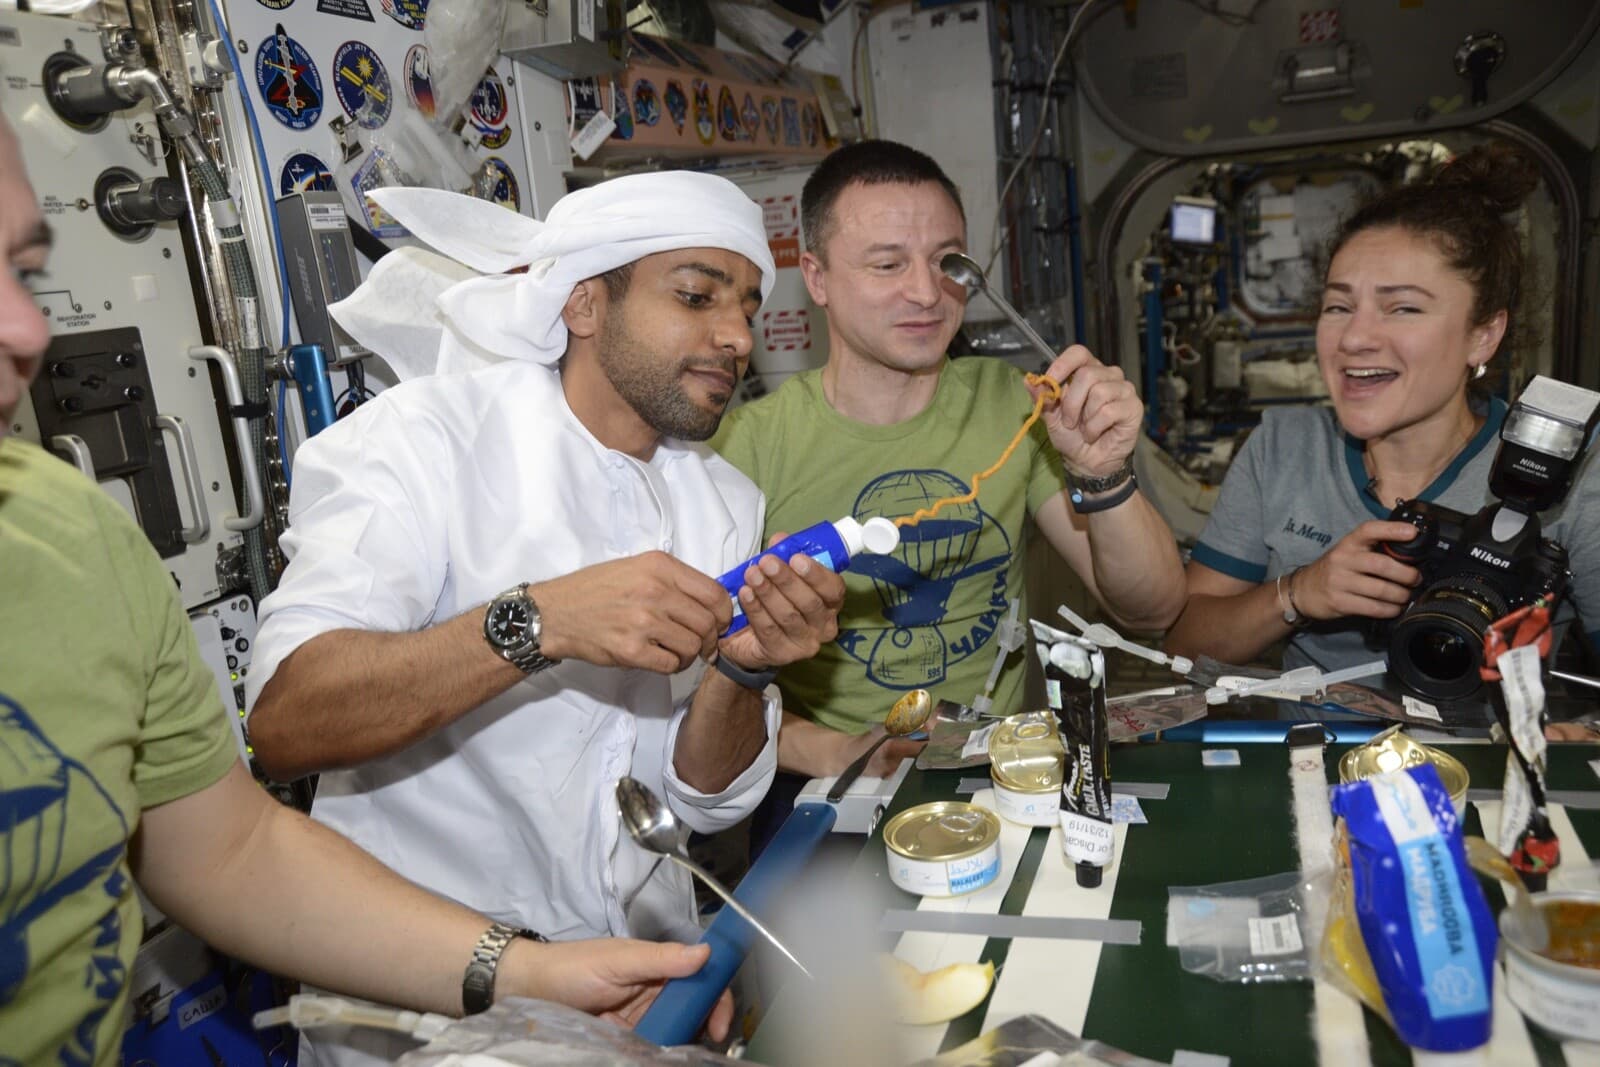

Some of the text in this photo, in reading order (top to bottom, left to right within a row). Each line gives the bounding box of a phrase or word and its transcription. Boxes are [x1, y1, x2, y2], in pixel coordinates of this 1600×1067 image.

[1519, 457, 1548, 473] Nikon
[1470, 547, 1511, 569] Nikon
[1078, 744, 1093, 775] PASTE
[1082, 773, 1100, 816] GARLIC
[1069, 820, 1110, 839] 12/31/19
[1425, 841, 1466, 956] MADHROOBA
